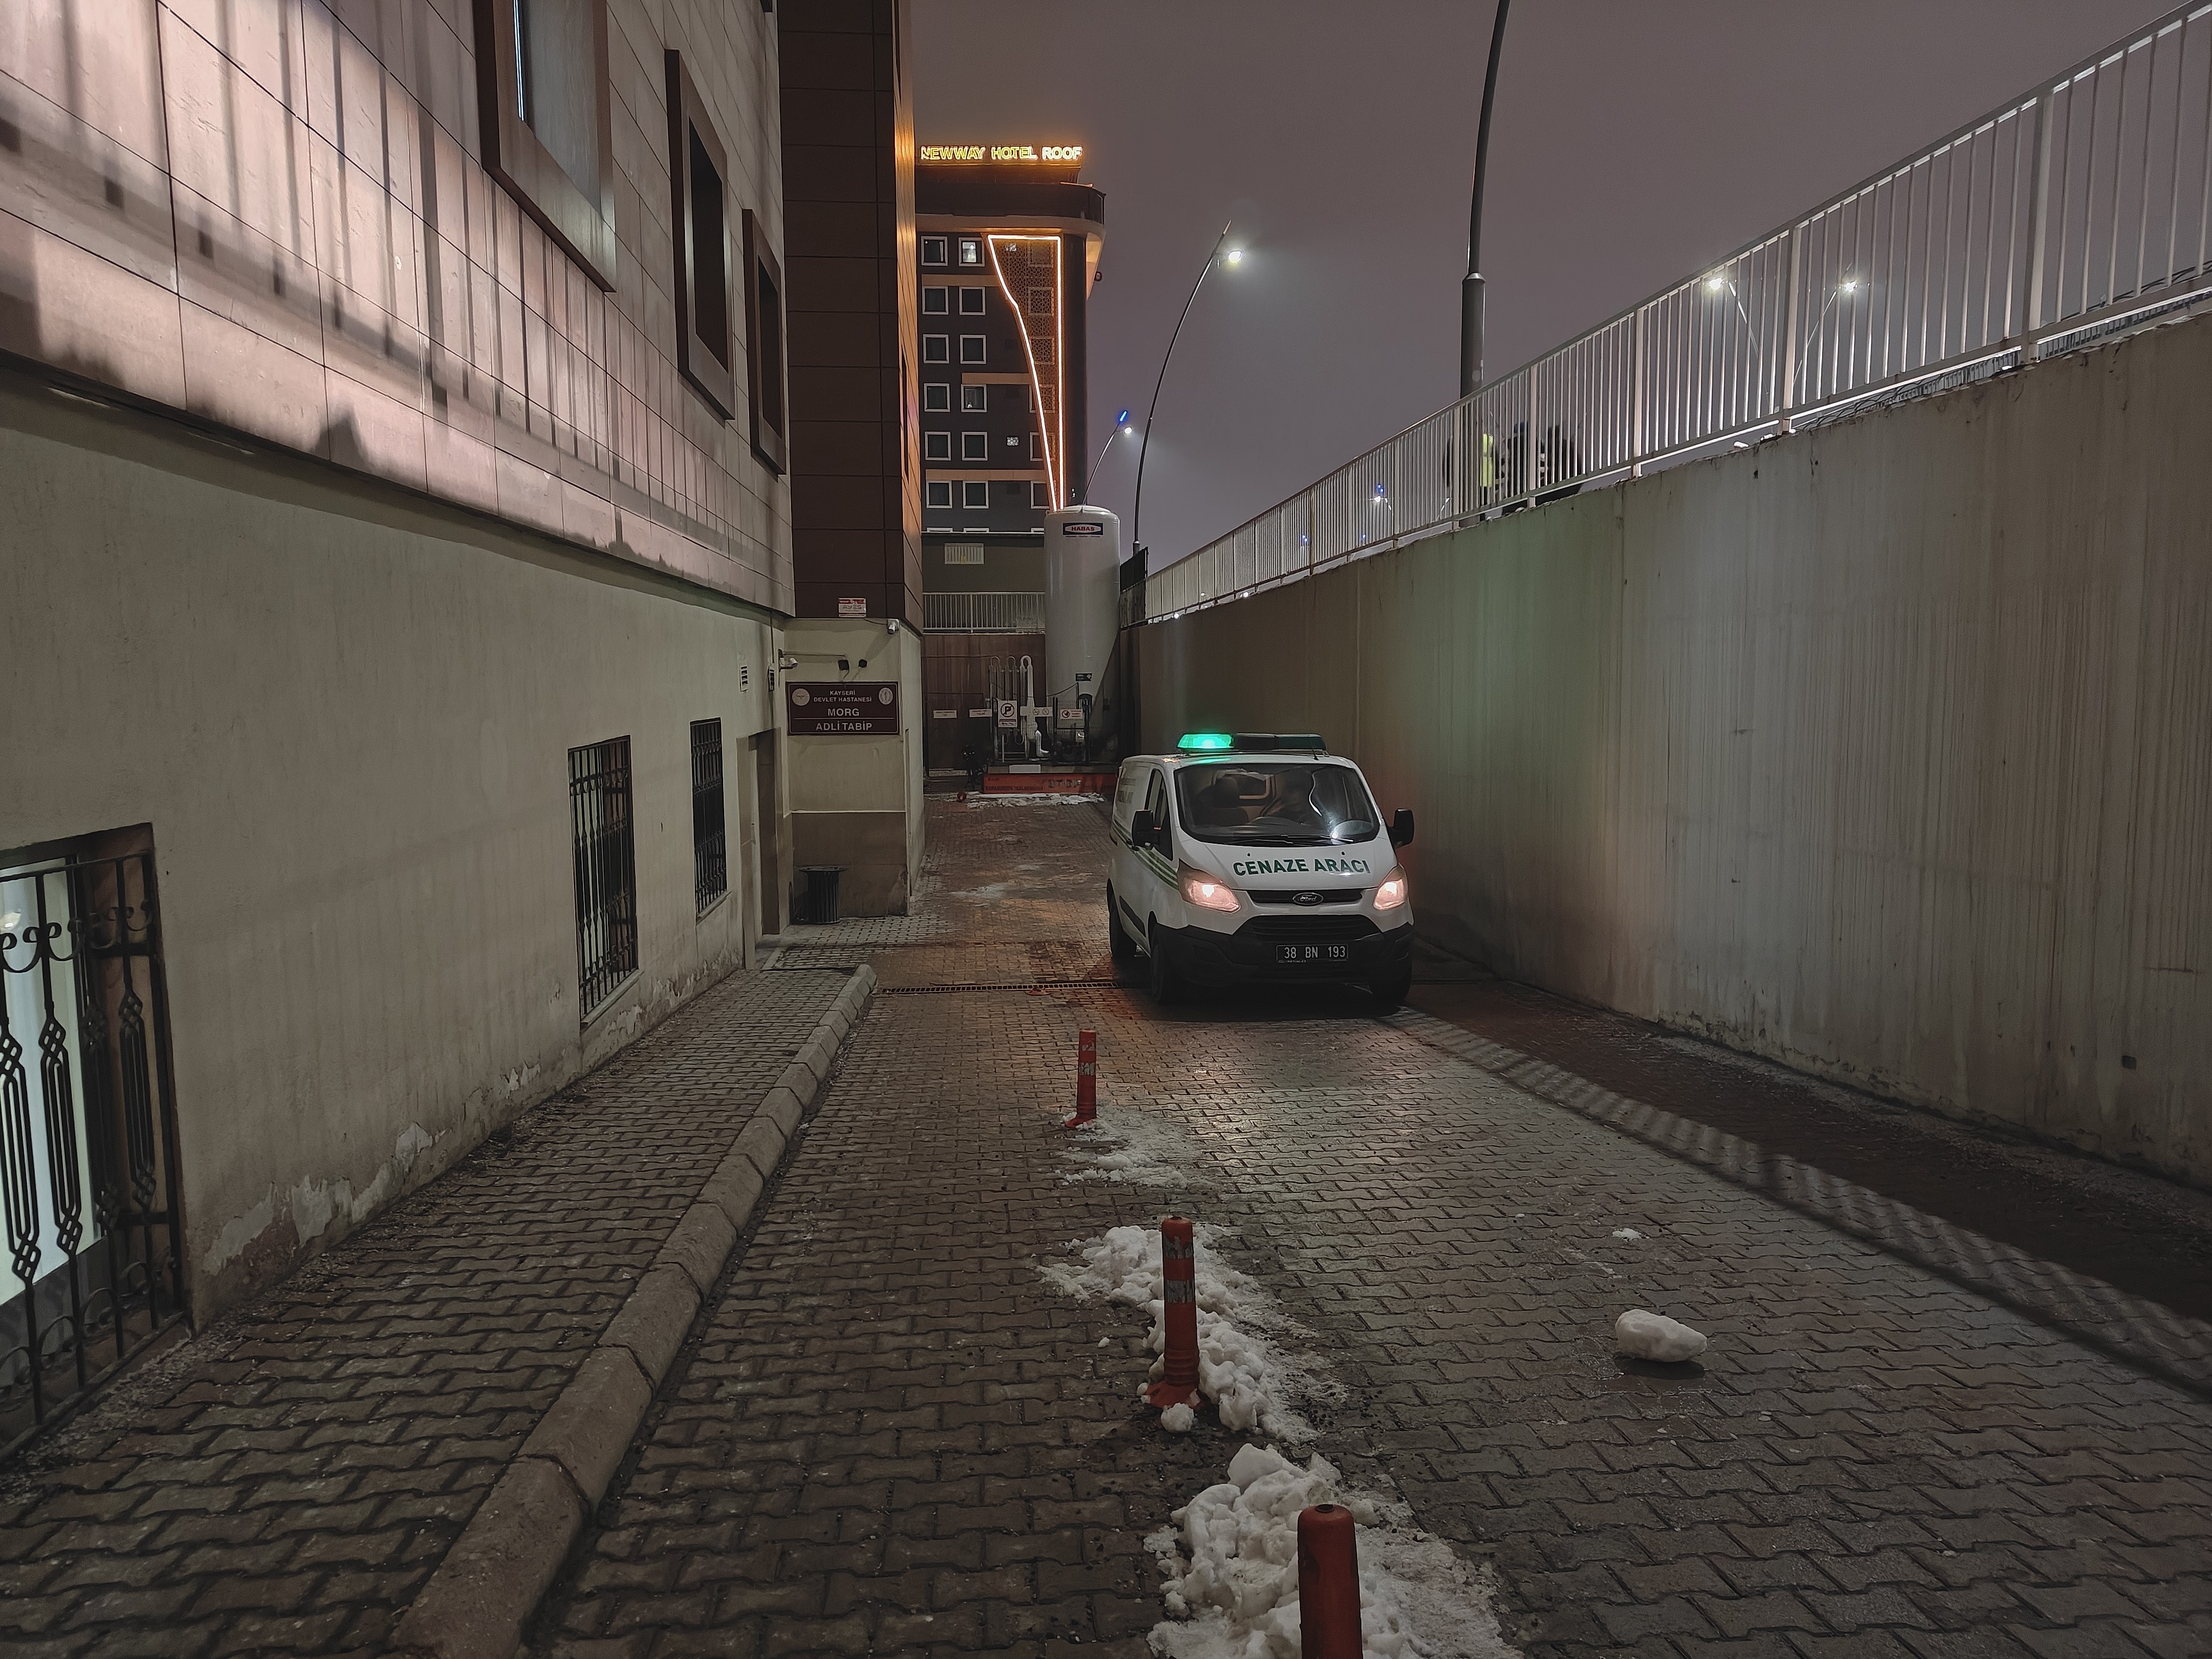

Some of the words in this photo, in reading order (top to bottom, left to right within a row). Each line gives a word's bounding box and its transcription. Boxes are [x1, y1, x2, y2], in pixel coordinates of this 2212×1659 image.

[921, 146, 985, 160] NEWWAY
[991, 146, 1038, 160] HOTEL
[1042, 146, 1083, 160] ROOF
[827, 709, 860, 717] MORG
[815, 720, 840, 731] ADLİ
[842, 720, 873, 731] TABİP
[1232, 859, 1309, 876] CENAZE
[1314, 858, 1370, 874] ARACI
[1284, 947, 1297, 959] 38
[1305, 946, 1318, 959] BN
[1327, 946, 1346, 958] 193
